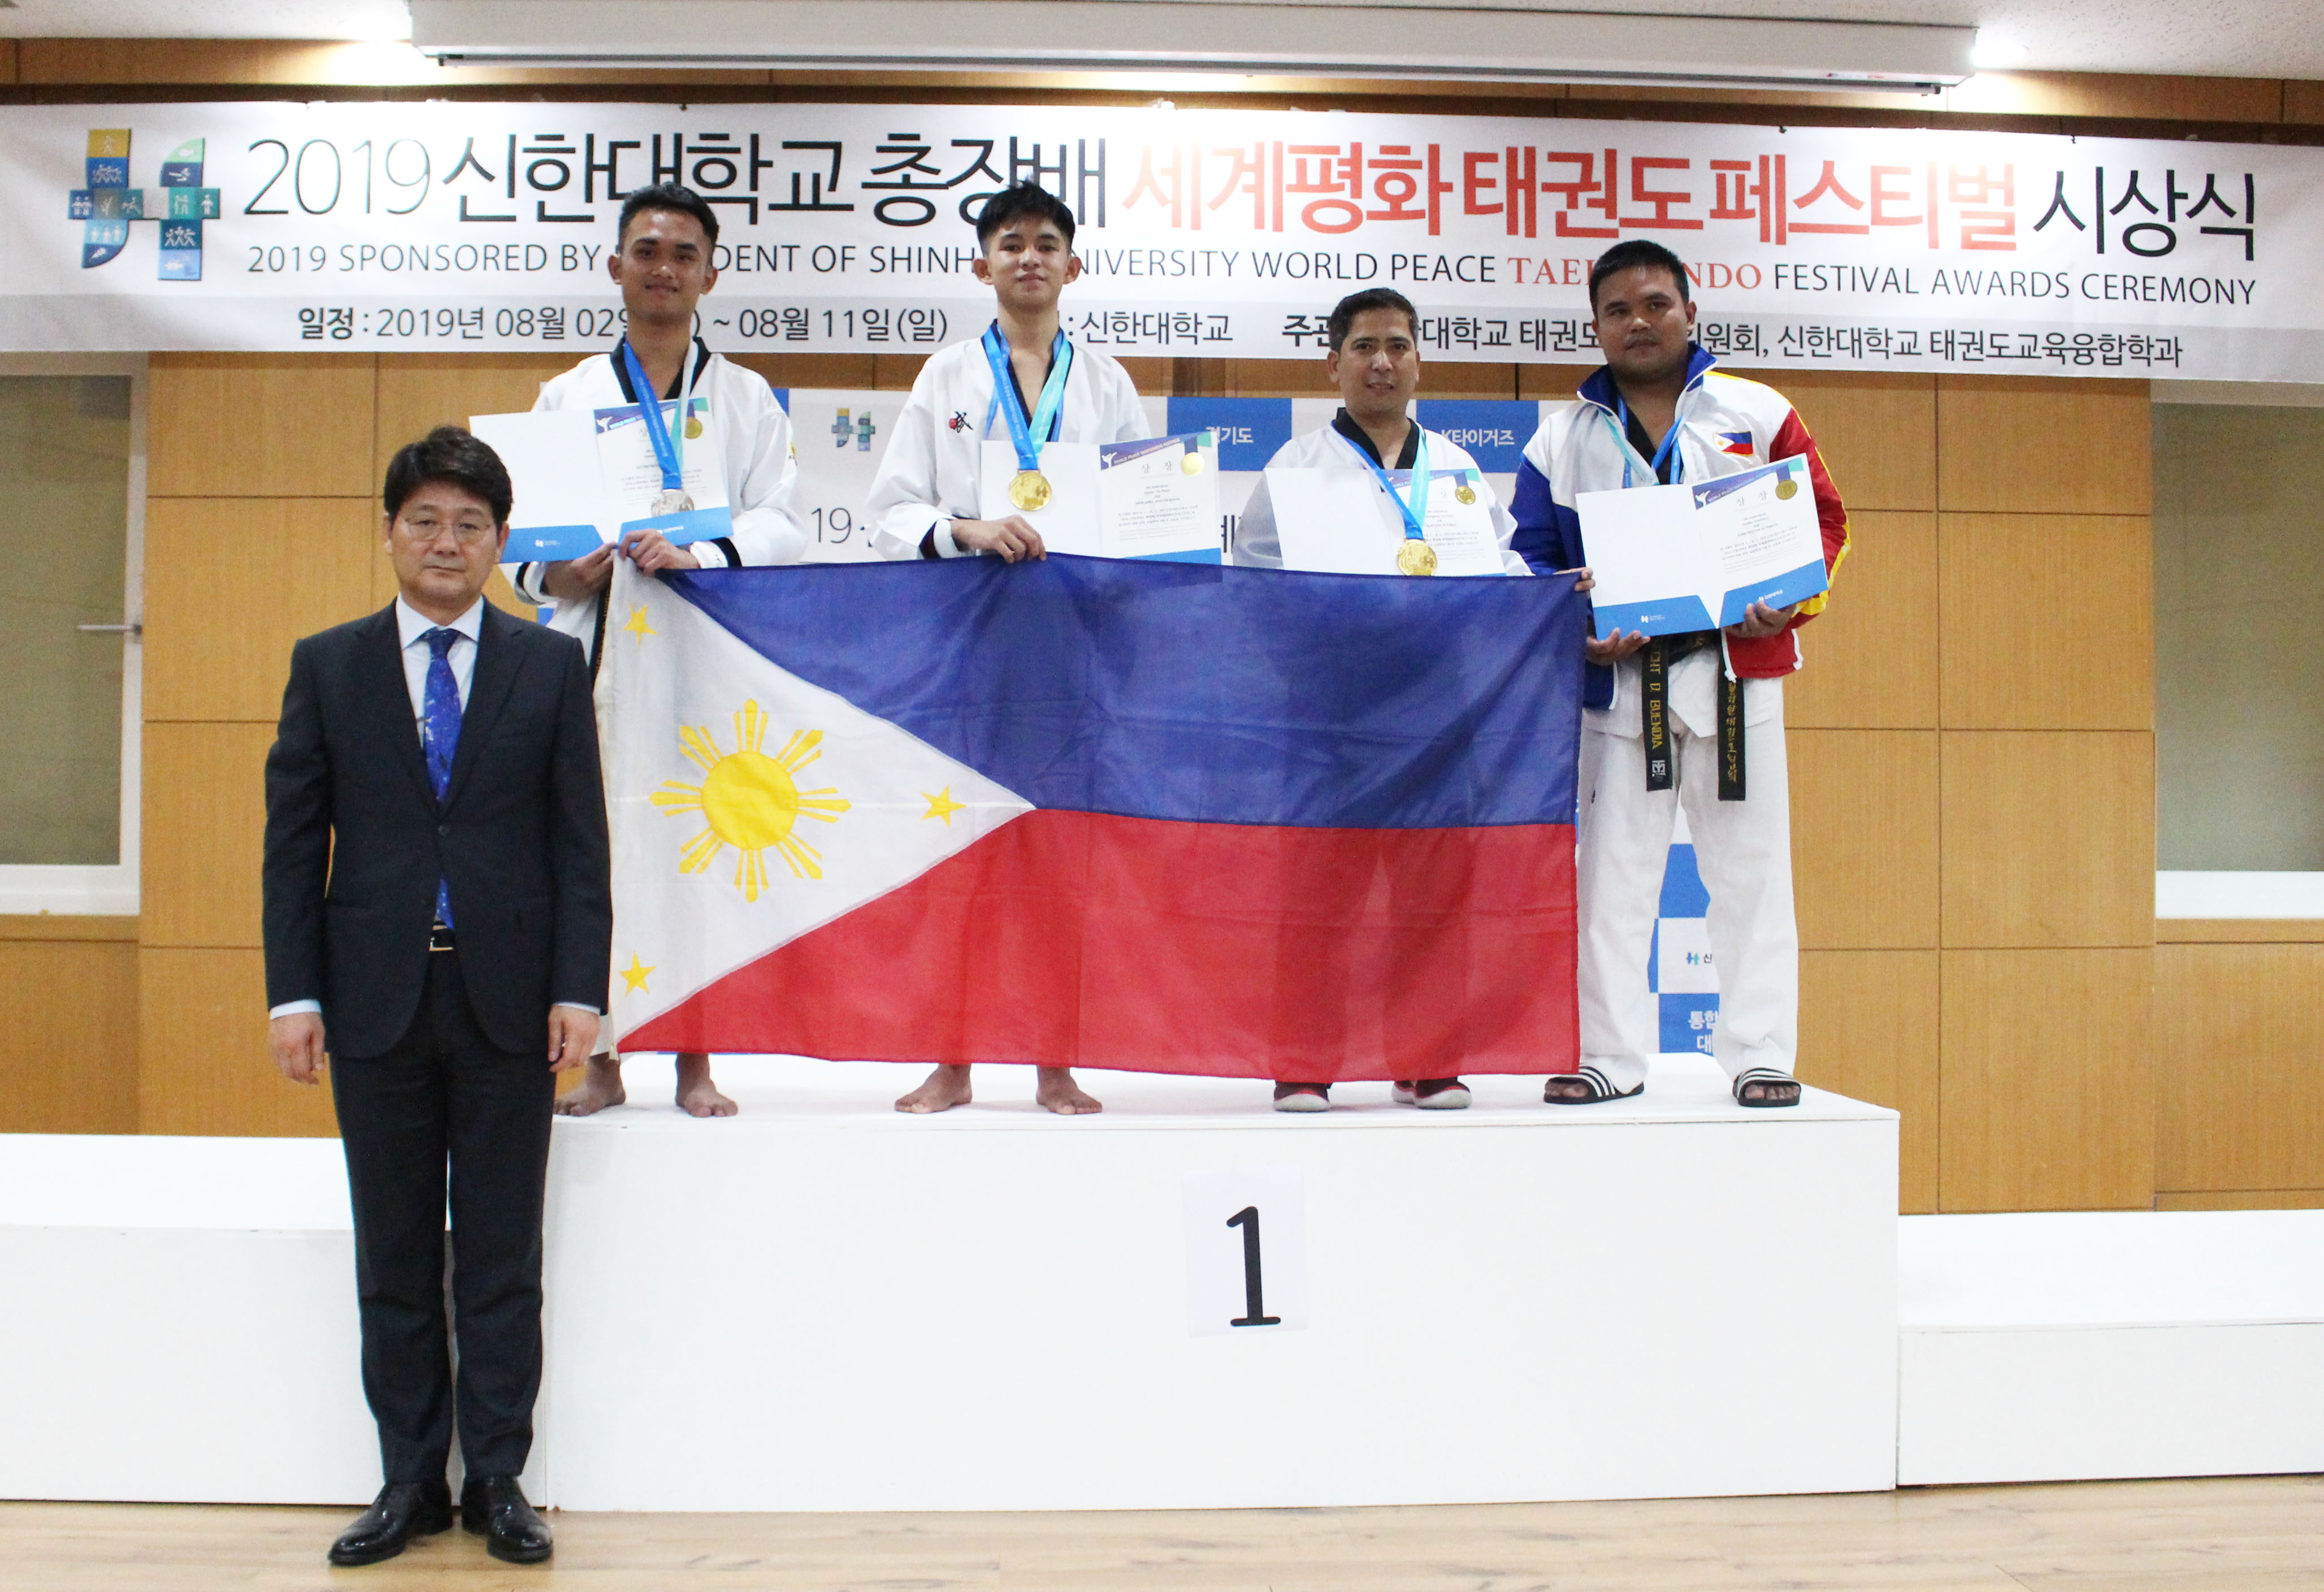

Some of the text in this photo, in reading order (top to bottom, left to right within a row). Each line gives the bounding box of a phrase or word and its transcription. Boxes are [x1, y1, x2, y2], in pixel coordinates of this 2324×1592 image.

[2033, 166, 2255, 261] 시상식
[248, 246, 326, 272] 2019
[340, 244, 547, 271] SPONSORED
[561, 244, 601, 271] BY
[812, 245, 856, 272] OF
[870, 245, 974, 274] SHINH
[1070, 248, 1238, 276] NIVERSITY
[1252, 252, 1377, 280] WORLD
[1391, 254, 1495, 283] PEACE
[1508, 257, 1761, 289] TAENDO
[1775, 264, 1919, 294] FESTIVAL
[1931, 269, 2069, 298] AWARDS
[2082, 274, 2256, 305] CEREMONY
[496, 306, 565, 340] 08월
[739, 308, 809, 341] 08월
[823, 309, 947, 343] 11일(일)
[1777, 325, 1922, 360] 신한대학교
[1930, 329, 2183, 367] 태권도교육융합학과
[1226, 1206, 1281, 1327] 1
